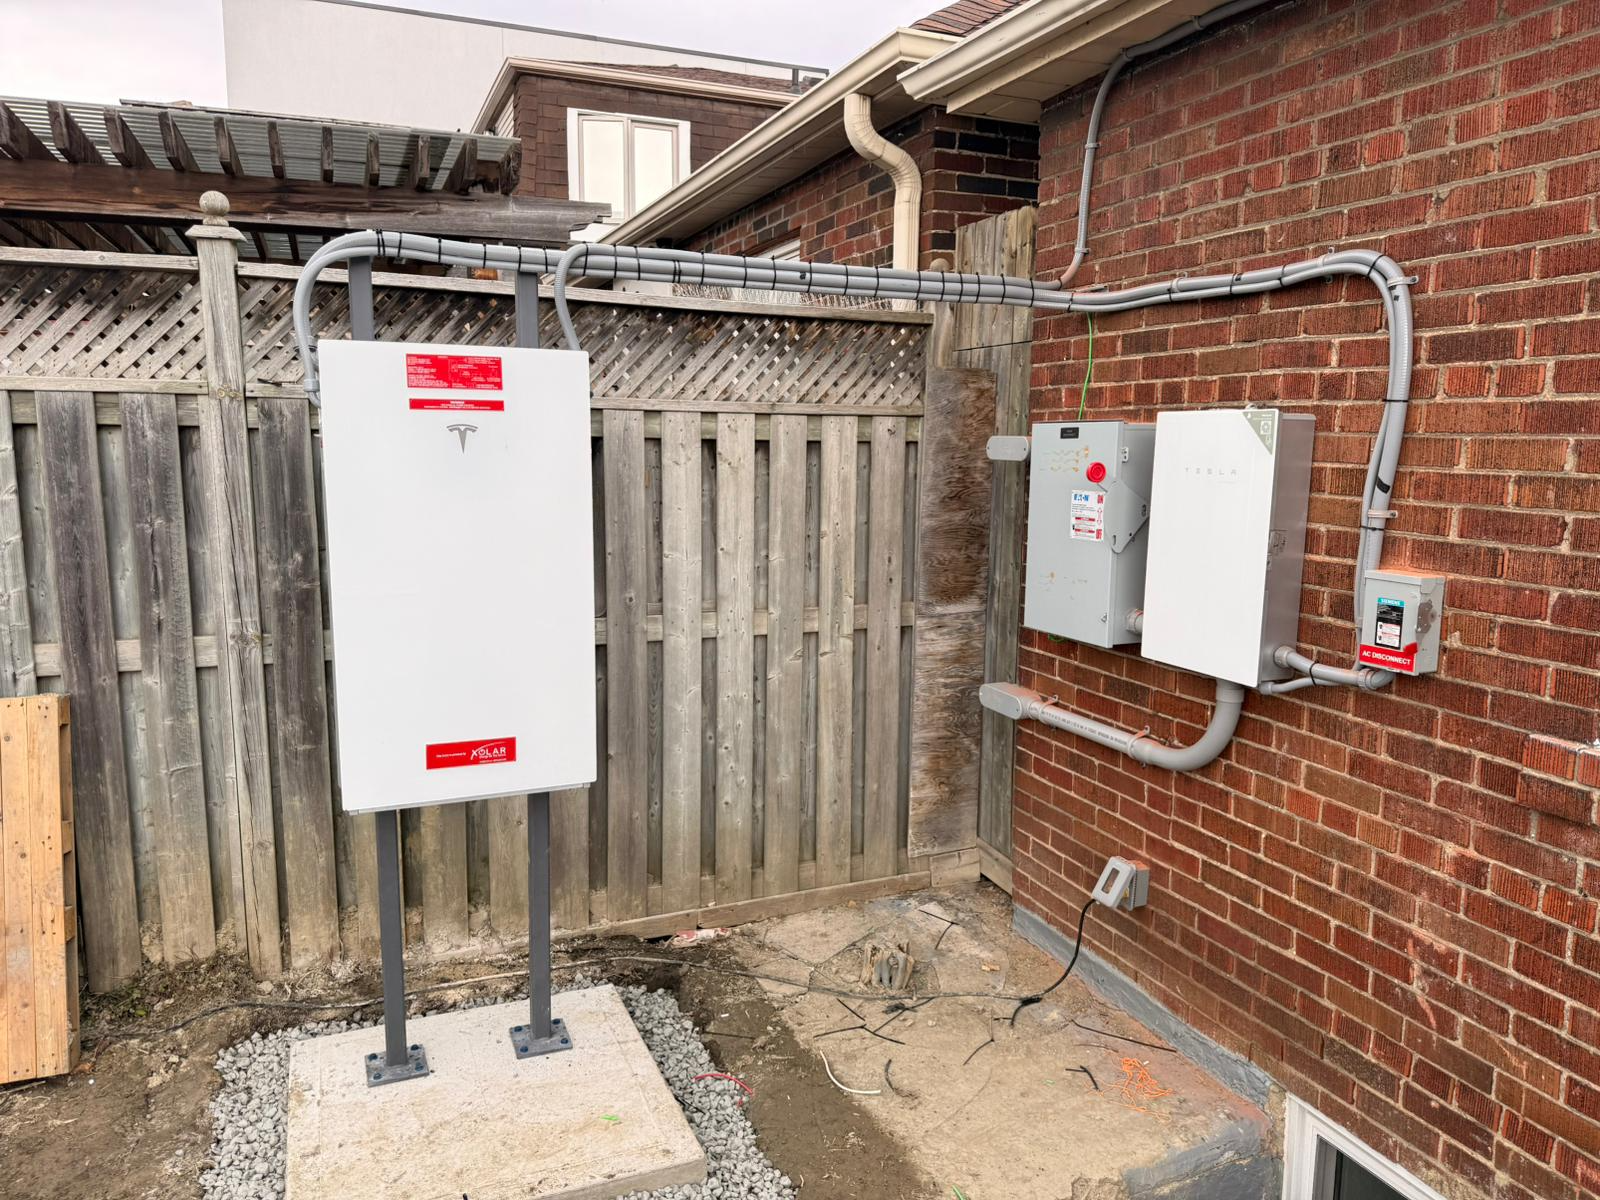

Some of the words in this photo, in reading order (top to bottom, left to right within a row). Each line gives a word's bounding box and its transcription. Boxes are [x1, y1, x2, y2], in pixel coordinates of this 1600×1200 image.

[1185, 466, 1237, 476] TESLA
[1372, 652, 1411, 665] DISCONNECT
[471, 747, 506, 760] XOLAR
